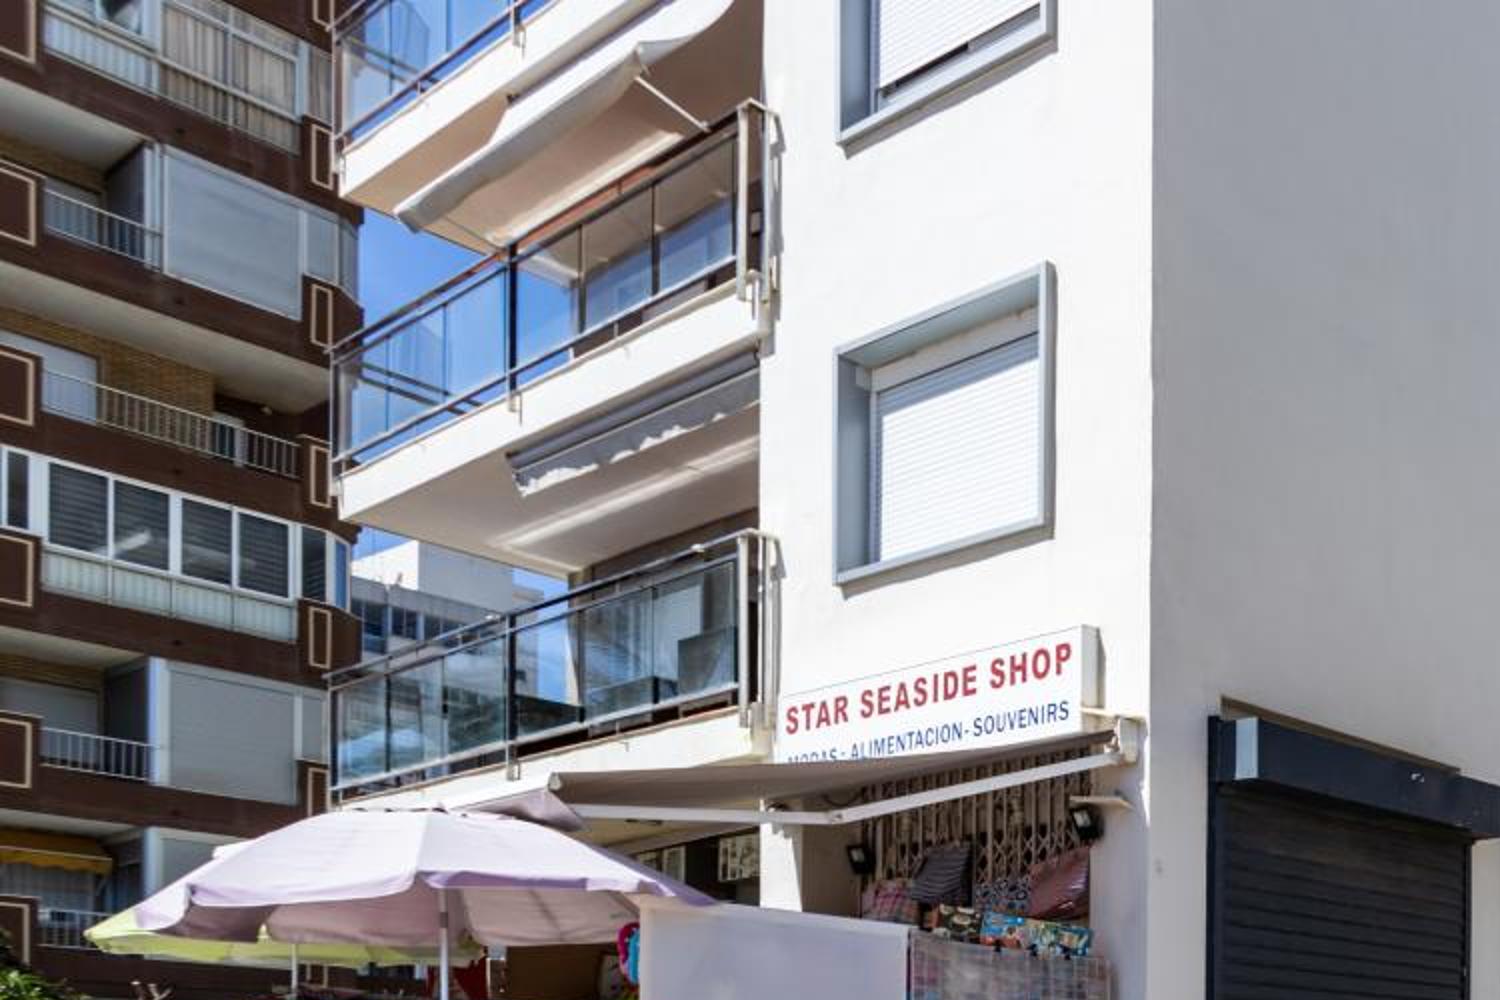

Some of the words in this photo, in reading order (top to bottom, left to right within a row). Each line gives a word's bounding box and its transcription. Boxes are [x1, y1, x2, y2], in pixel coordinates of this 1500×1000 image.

[785, 695, 849, 735] STAR
[860, 665, 977, 719] SEASIDE
[989, 643, 1072, 690] SHOP
